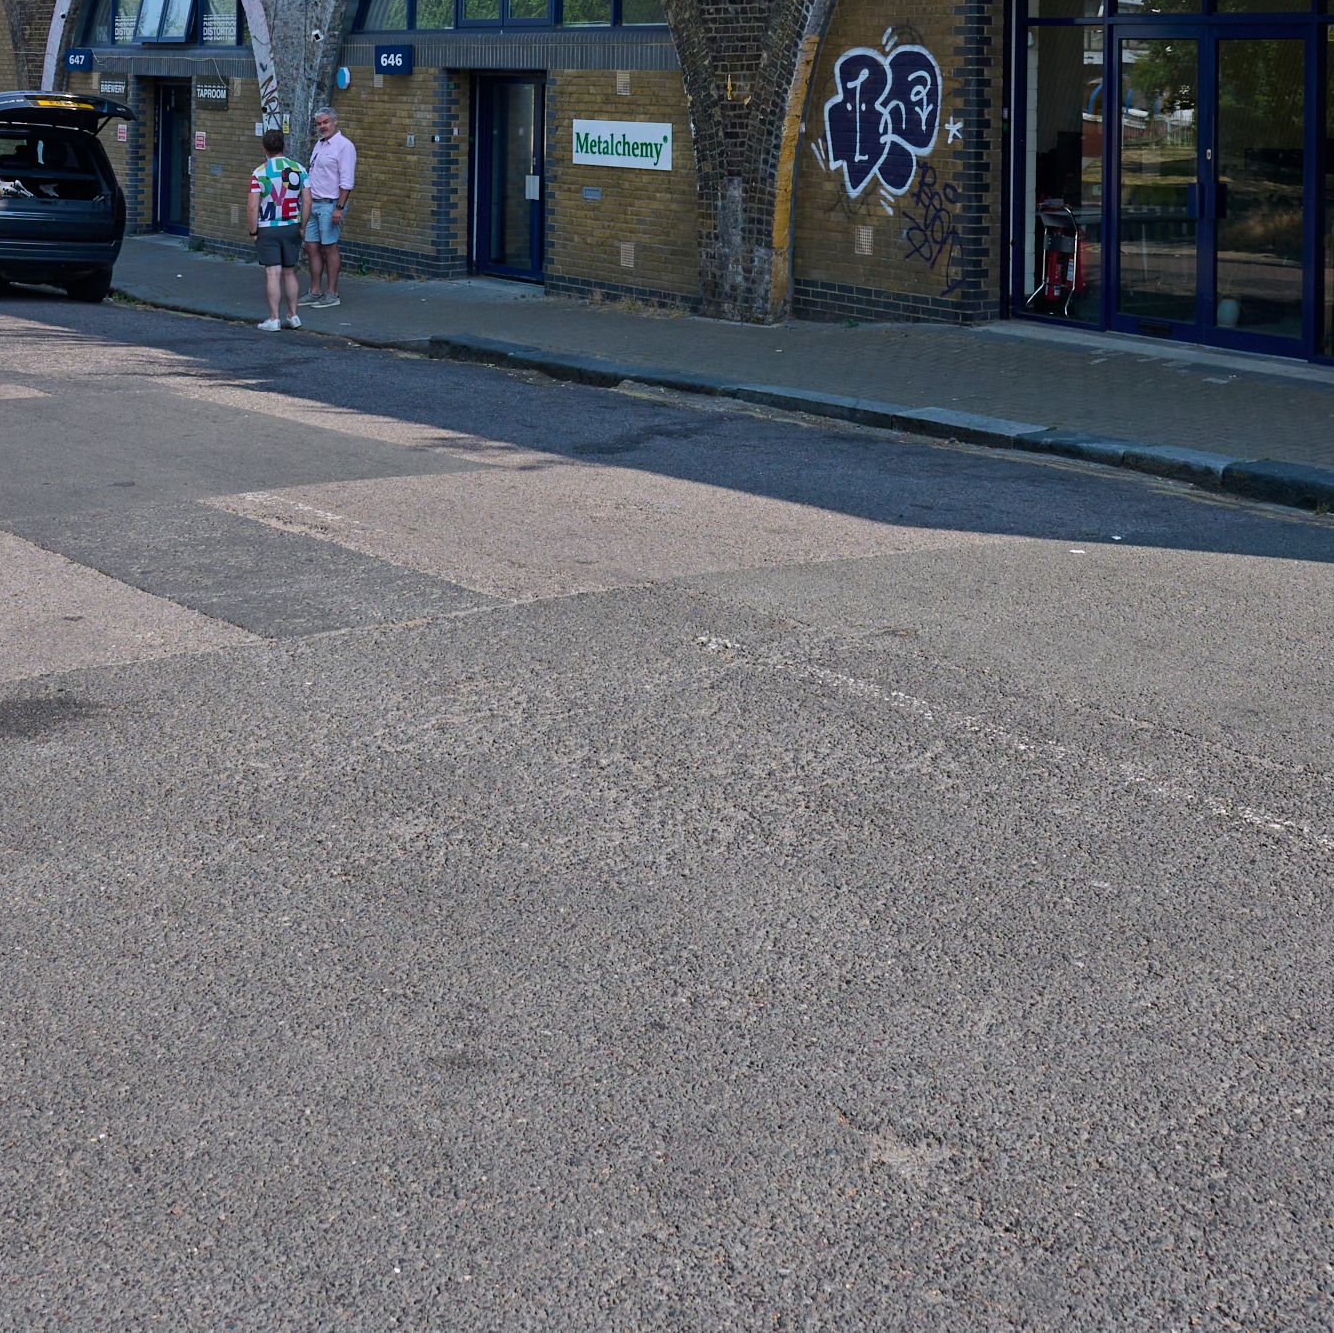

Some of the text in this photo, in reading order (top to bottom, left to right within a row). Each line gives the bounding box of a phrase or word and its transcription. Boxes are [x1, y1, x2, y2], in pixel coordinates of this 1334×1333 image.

[69, 55, 85, 65] 647
[380, 53, 403, 67] 646
[100, 83, 126, 94] BREWERY
[196, 88, 227, 99] TAPROOM
